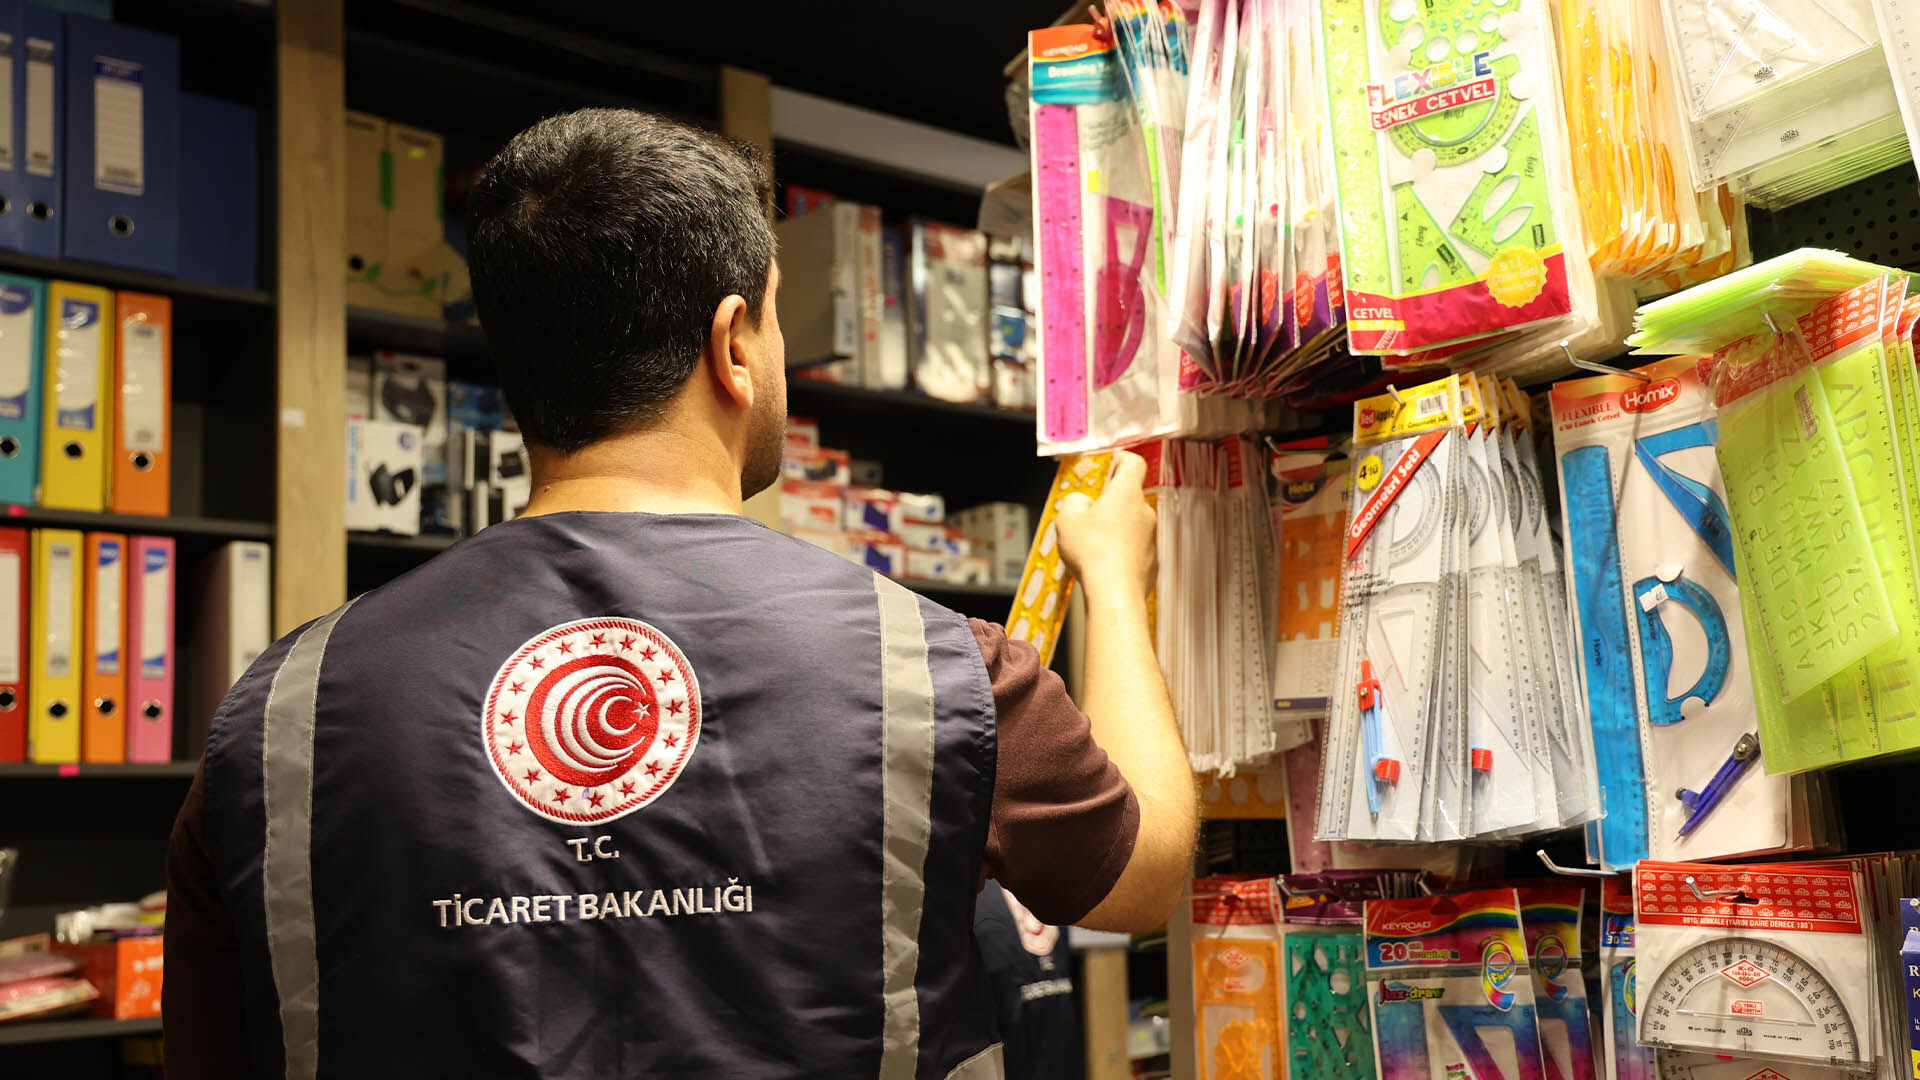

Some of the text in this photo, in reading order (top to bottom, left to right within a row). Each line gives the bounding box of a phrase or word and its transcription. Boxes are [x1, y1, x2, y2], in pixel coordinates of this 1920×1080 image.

[1366, 52, 1493, 107] FLEXIBLE
[1372, 82, 1494, 128] ESNEK CETVEL
[1353, 307, 1395, 319] CETVEL
[1624, 384, 1676, 409] Homix
[1562, 401, 1613, 422] FLEXIBLE
[567, 835, 620, 862] T.C.
[432, 877, 753, 927] TİCARET BAKANLIĞI
[1382, 921, 1432, 932] KEYROAD
[1380, 943, 1408, 961] 20
